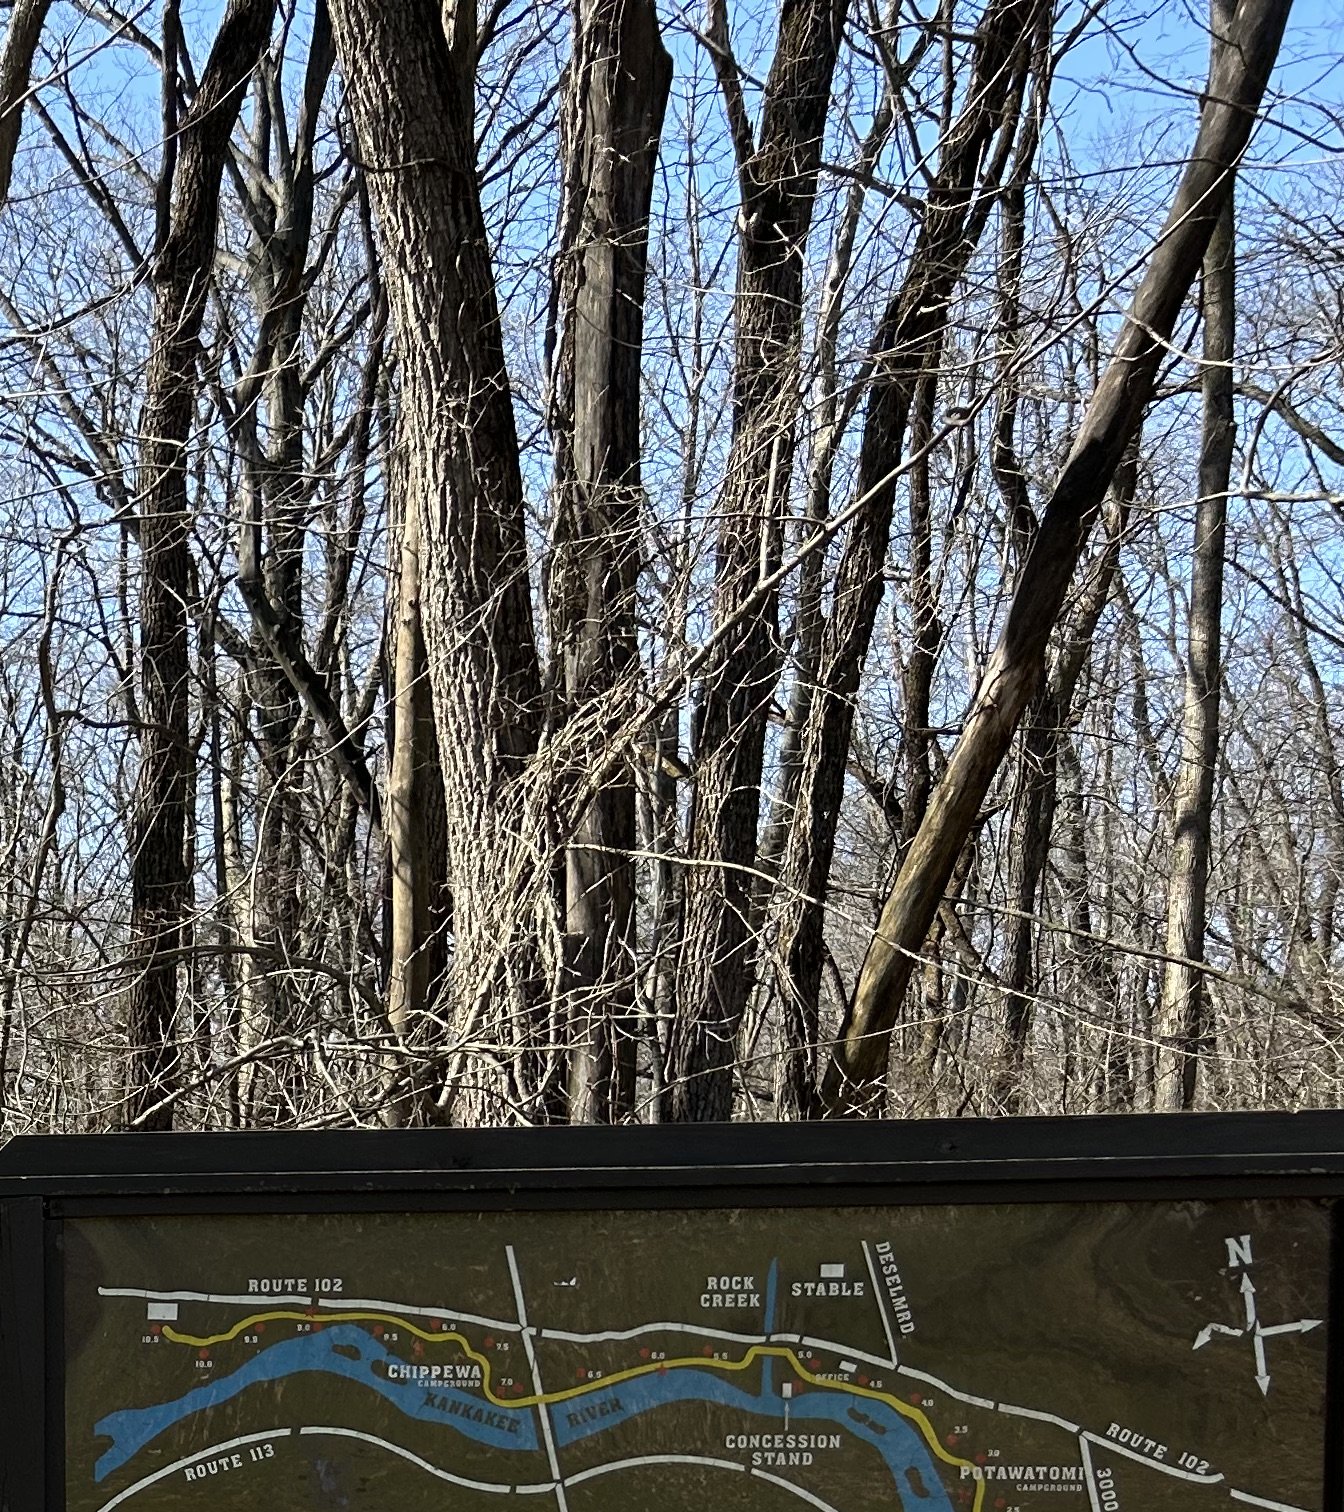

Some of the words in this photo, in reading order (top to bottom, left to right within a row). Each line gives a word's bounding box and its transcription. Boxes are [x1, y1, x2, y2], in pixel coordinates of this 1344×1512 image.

[1225, 1234, 1252, 1267] N
[248, 1279, 308, 1292] ROUTE
[315, 1279, 343, 1292] 102
[707, 1276, 754, 1290] ROCK
[791, 1282, 864, 1296] STABLE
[700, 1294, 760, 1307] CREEK
[388, 1364, 481, 1379] CHIPPEWA
[418, 1380, 480, 1388] CAMPGROUND
[423, 1391, 521, 1433] KANKAKEE
[567, 1397, 624, 1428] RIVER
[725, 1435, 841, 1449] CONCESSION
[1106, 1423, 1168, 1459] ROUTE
[1178, 1452, 1210, 1474] 102
[184, 1453, 243, 1481] ROUTE
[250, 1443, 275, 1461] 113
[752, 1452, 813, 1465] STAND
[960, 1466, 1084, 1480] POTAWATOMI
[1016, 1484, 1082, 1492] CAMPGROUND
[1097, 1468, 1119, 1511] 3000
